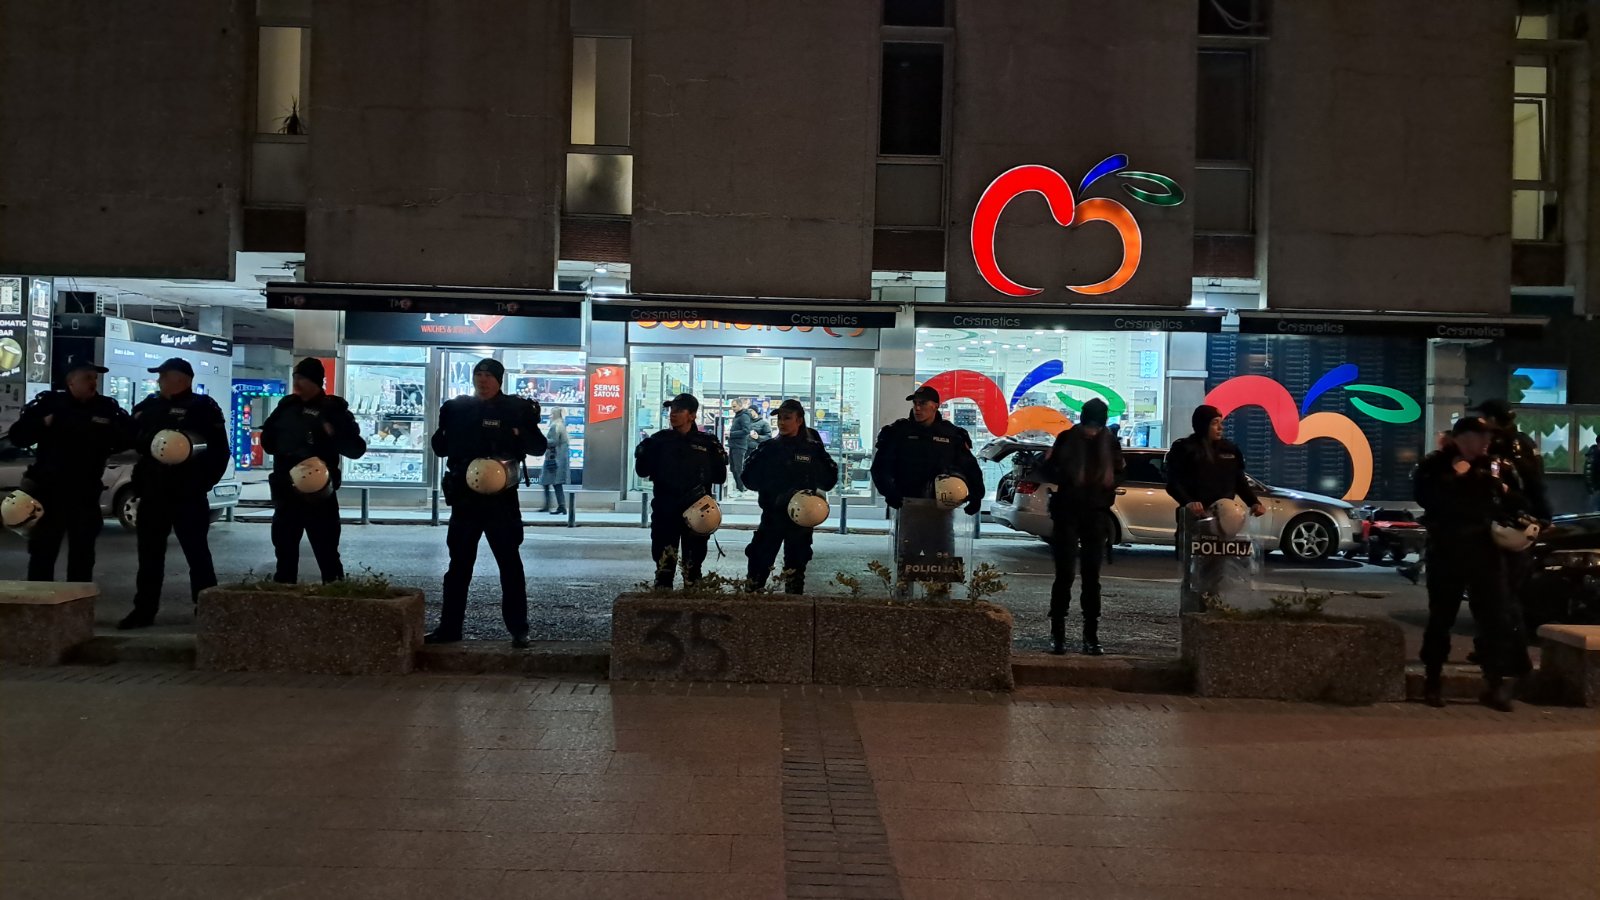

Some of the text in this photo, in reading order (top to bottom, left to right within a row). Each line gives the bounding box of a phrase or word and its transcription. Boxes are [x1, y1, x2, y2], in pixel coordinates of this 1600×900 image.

[631, 308, 698, 320] Cosmetics
[791, 312, 858, 326] Cosmetics
[953, 315, 1021, 328] Cosmetics
[1114, 318, 1182, 330] Cosmetics
[1277, 321, 1344, 334] Cosmetics
[421, 325, 447, 333] WATCHES
[1436, 324, 1505, 337] Cosmetics
[1191, 541, 1254, 555] POLICIJA
